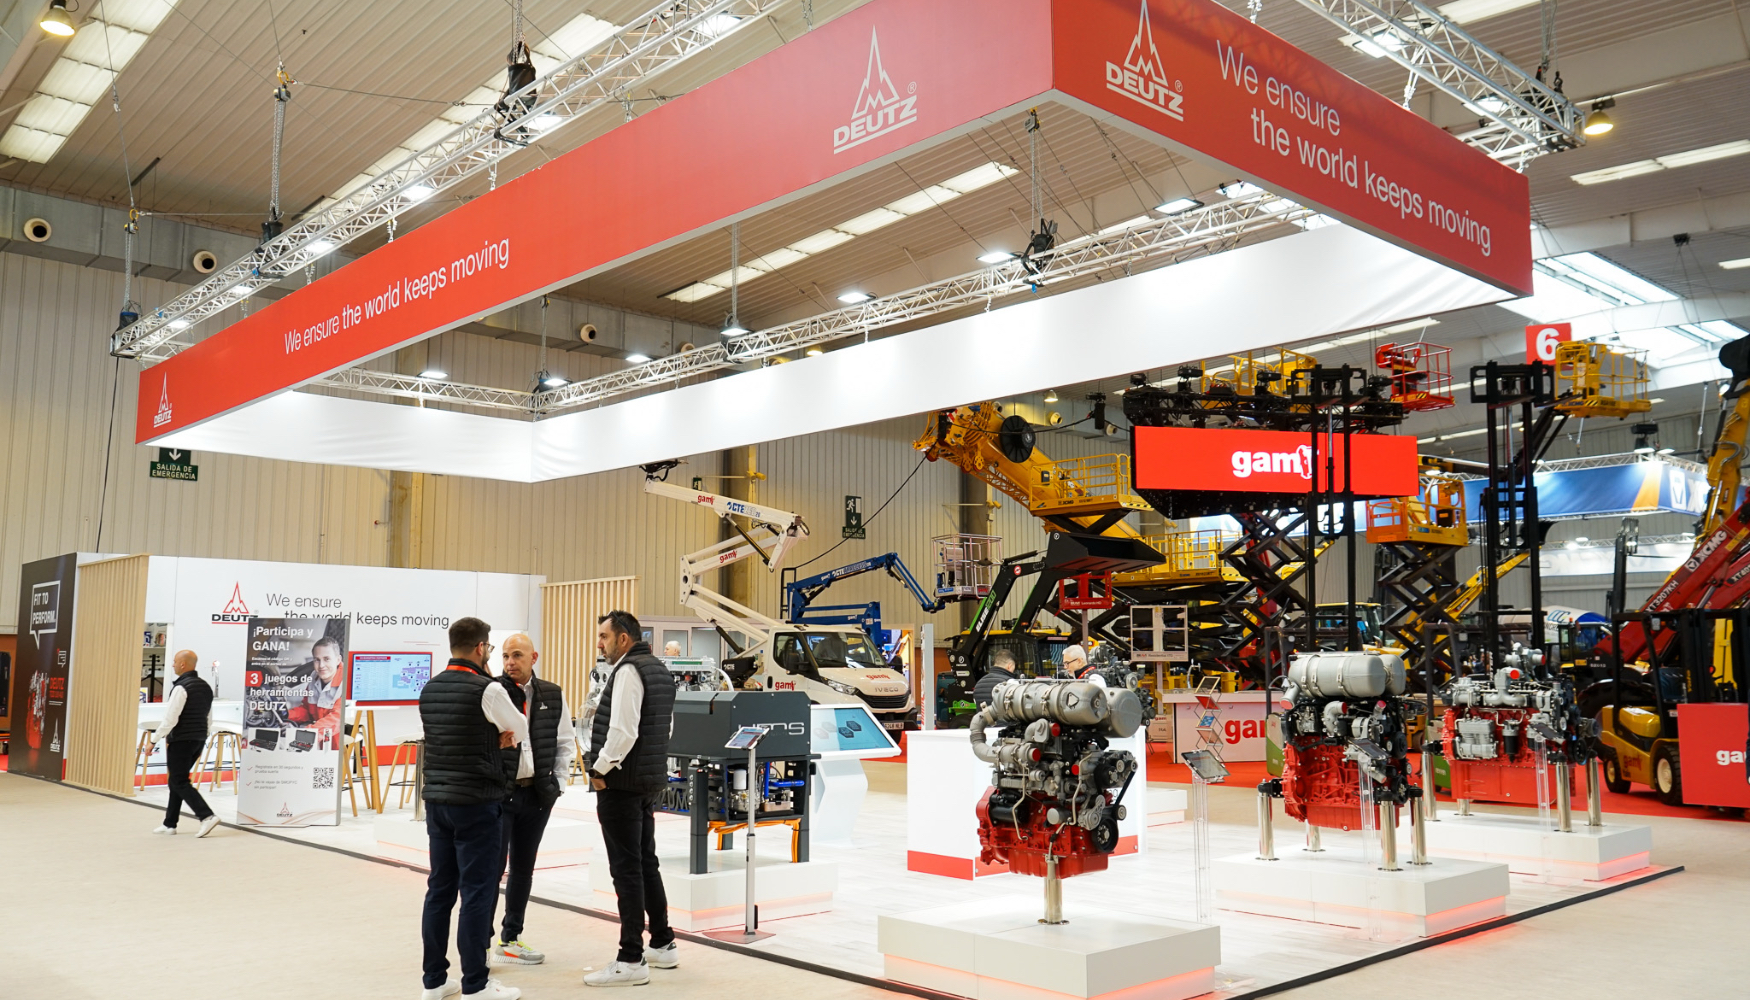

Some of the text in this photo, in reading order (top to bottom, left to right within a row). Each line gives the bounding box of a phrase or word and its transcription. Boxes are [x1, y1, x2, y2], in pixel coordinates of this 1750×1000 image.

[1106, 61, 1184, 114] DEUTZ
[1217, 40, 1340, 136] We ensure
[834, 94, 917, 148] DEUTZ
[1251, 108, 1491, 256] the world keeps moving
[284, 238, 509, 354] We ensure the world keeps moving
[1536, 328, 1560, 360] 6
[154, 410, 172, 424] DEUTZ
[152, 470, 195, 480] EMERGENCIA
[732, 503, 744, 513] CTE
[1695, 530, 1728, 563] XCMG
[42, 592, 49, 605] TO
[267, 593, 342, 608] We ensure
[356, 612, 398, 628] keeps
[402, 615, 449, 629] moving
[253, 626, 314, 638] ¡Participa y
[253, 641, 290, 651] GANA!
[250, 673, 312, 684] 3 juegos de
[250, 688, 314, 697] herramientas
[250, 702, 287, 710] DEUTZ
[1224, 719, 1266, 744] ga
[1716, 750, 1746, 765] ga
